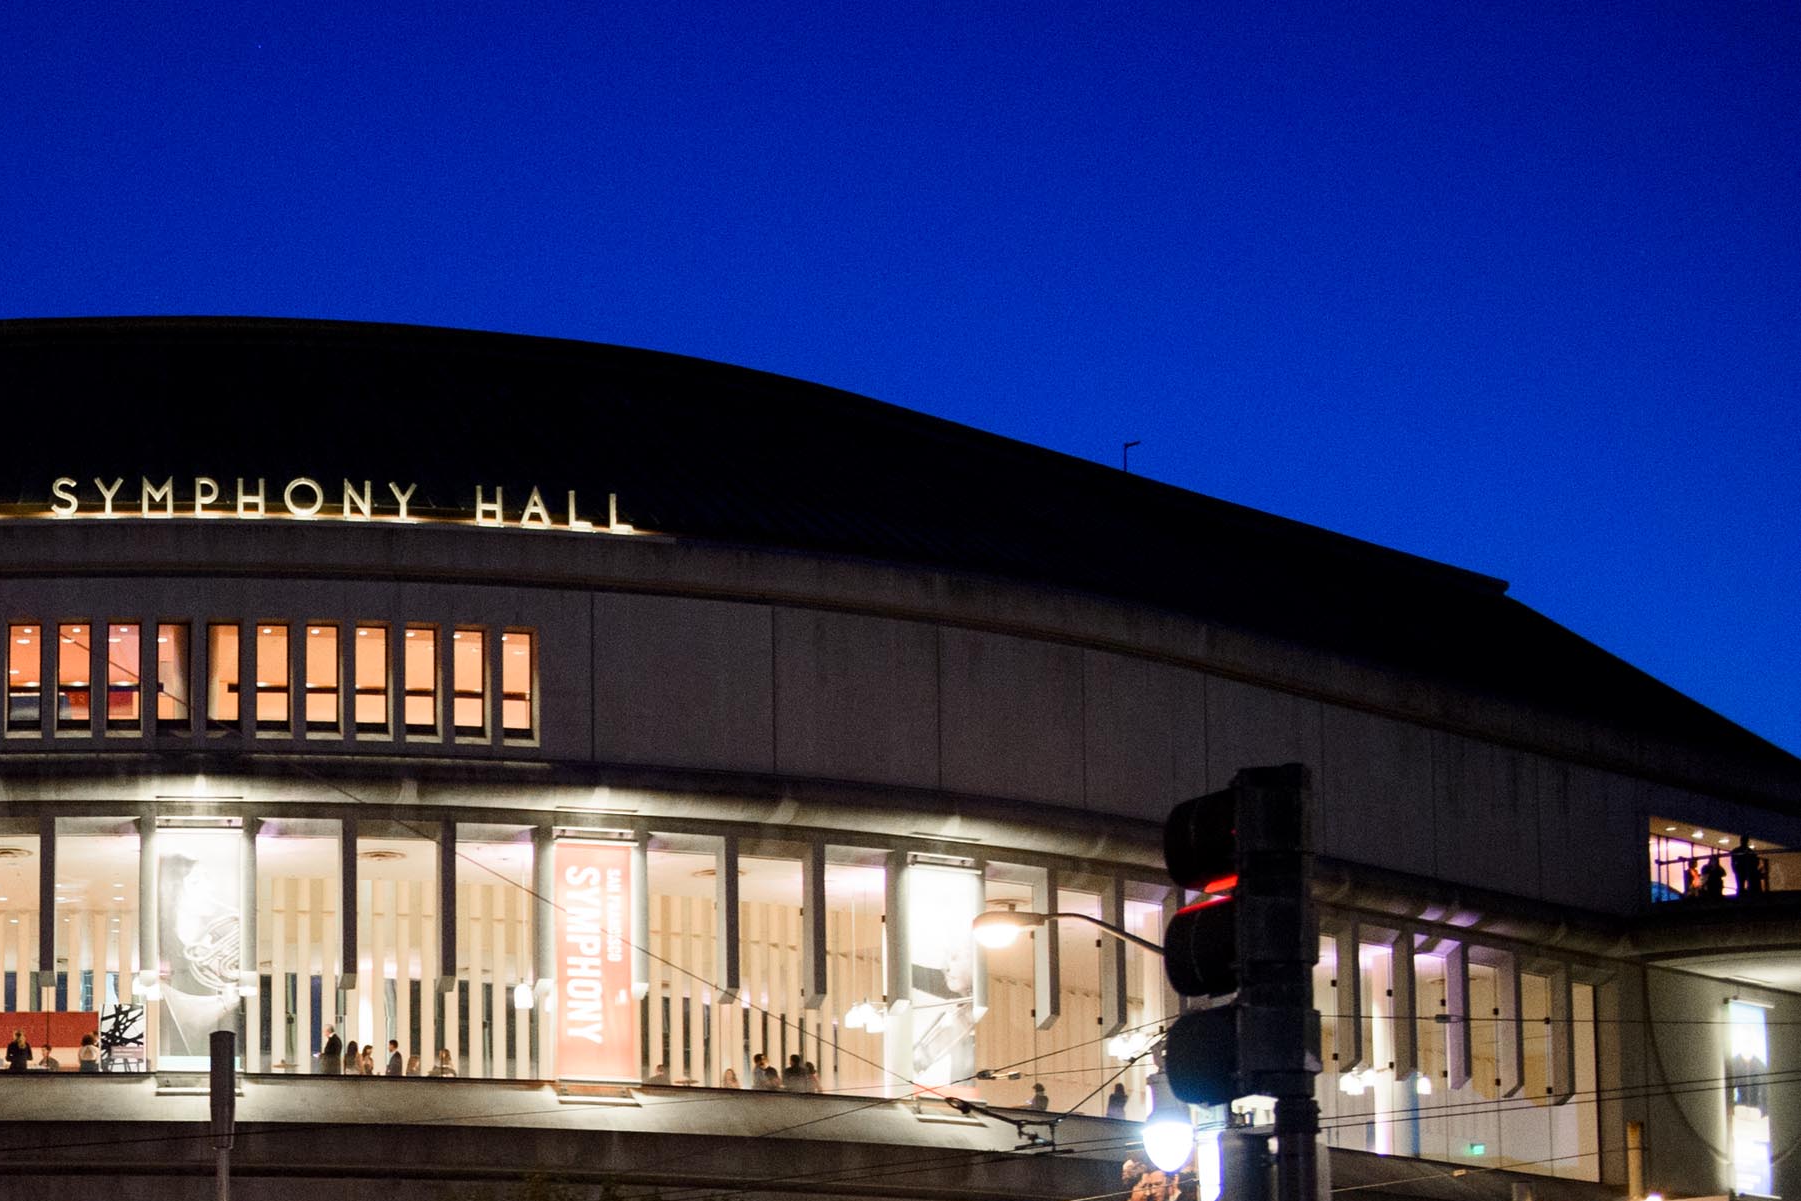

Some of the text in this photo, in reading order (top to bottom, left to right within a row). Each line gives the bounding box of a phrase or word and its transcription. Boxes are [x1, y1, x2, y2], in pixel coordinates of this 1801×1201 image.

[50, 476, 417, 520] SYMPHONY
[475, 485, 636, 534] HALL
[565, 865, 604, 1044] SYMPHONY
